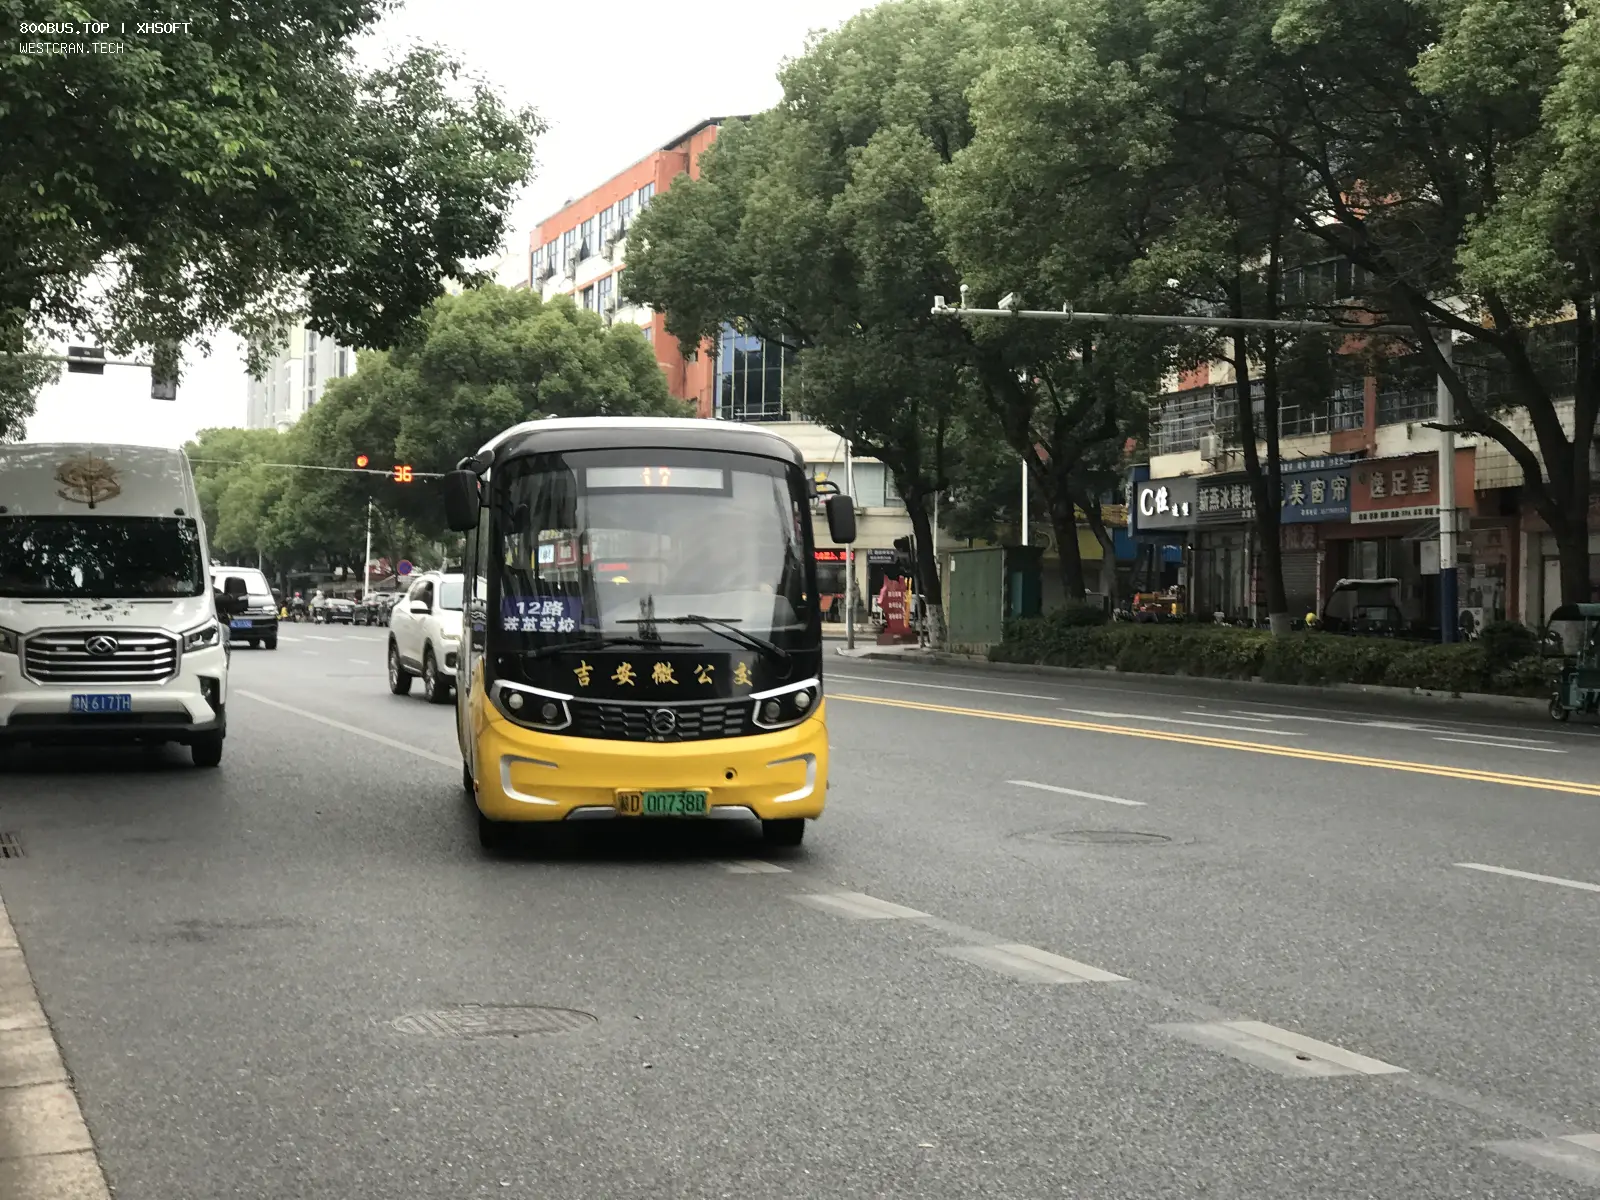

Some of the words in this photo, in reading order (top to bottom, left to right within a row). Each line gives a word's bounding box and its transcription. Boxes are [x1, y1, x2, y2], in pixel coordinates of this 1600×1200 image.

[394, 465, 412, 482] 36
[1199, 484, 1257, 512] 新燕冰棒批
[1280, 524, 1316, 550] 批发
[516, 600, 565, 617] 12路
[573, 660, 753, 687] 吉安微公交
